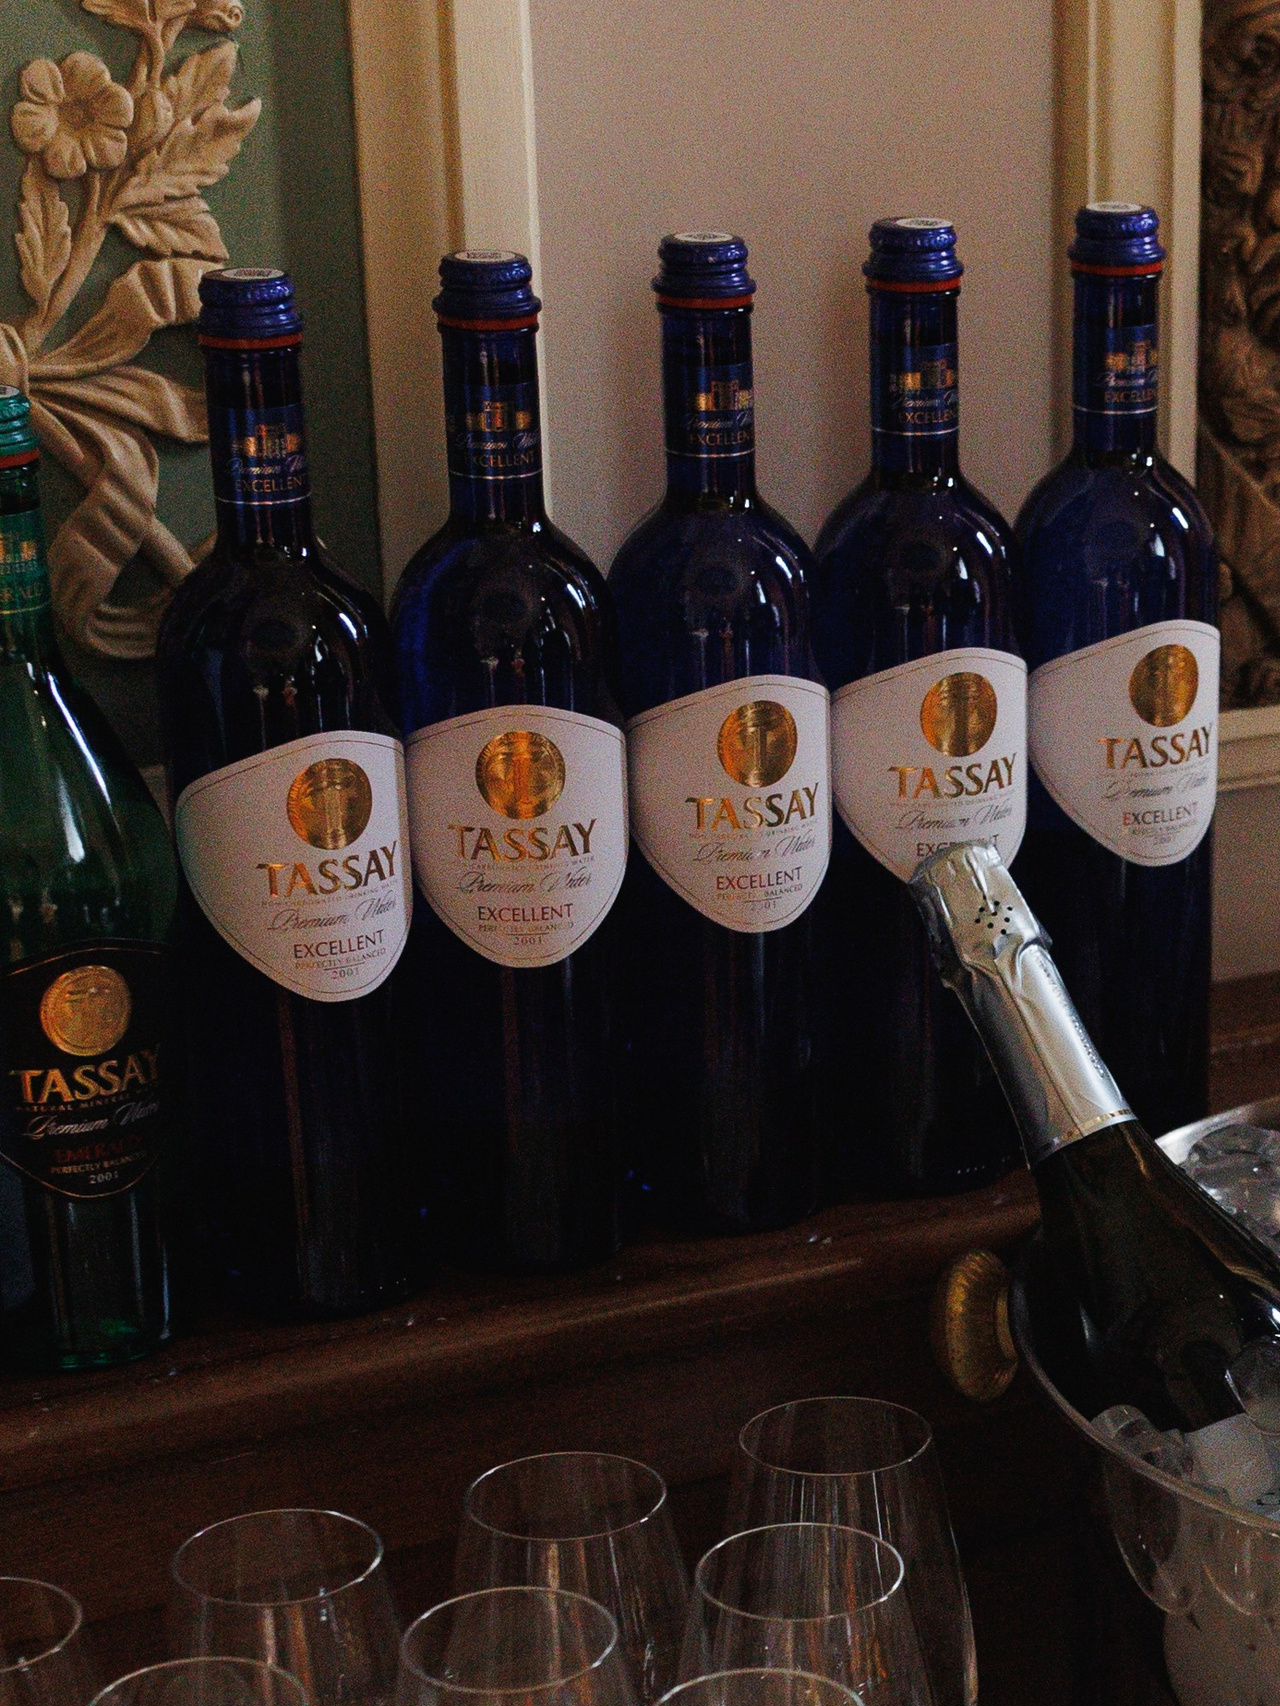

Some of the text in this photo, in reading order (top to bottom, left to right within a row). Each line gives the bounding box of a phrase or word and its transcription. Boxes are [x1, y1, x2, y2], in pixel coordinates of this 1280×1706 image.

[1098, 722, 1213, 769] TASSAY
[887, 751, 1018, 799] TASSAY
[684, 782, 820, 831] TASSAY
[1122, 801, 1199, 826] EXCELLENT
[447, 818, 597, 863] TASSAY
[255, 840, 398, 898] TASSAY
[715, 866, 803, 891] EXCELLENT
[266, 908, 350, 931] Premium
[477, 903, 574, 923] EXCELLENT
[293, 929, 385, 959] EXCELLENT
[8, 1050, 158, 1104] TASSAY
[22, 1114, 109, 1140] Premium
